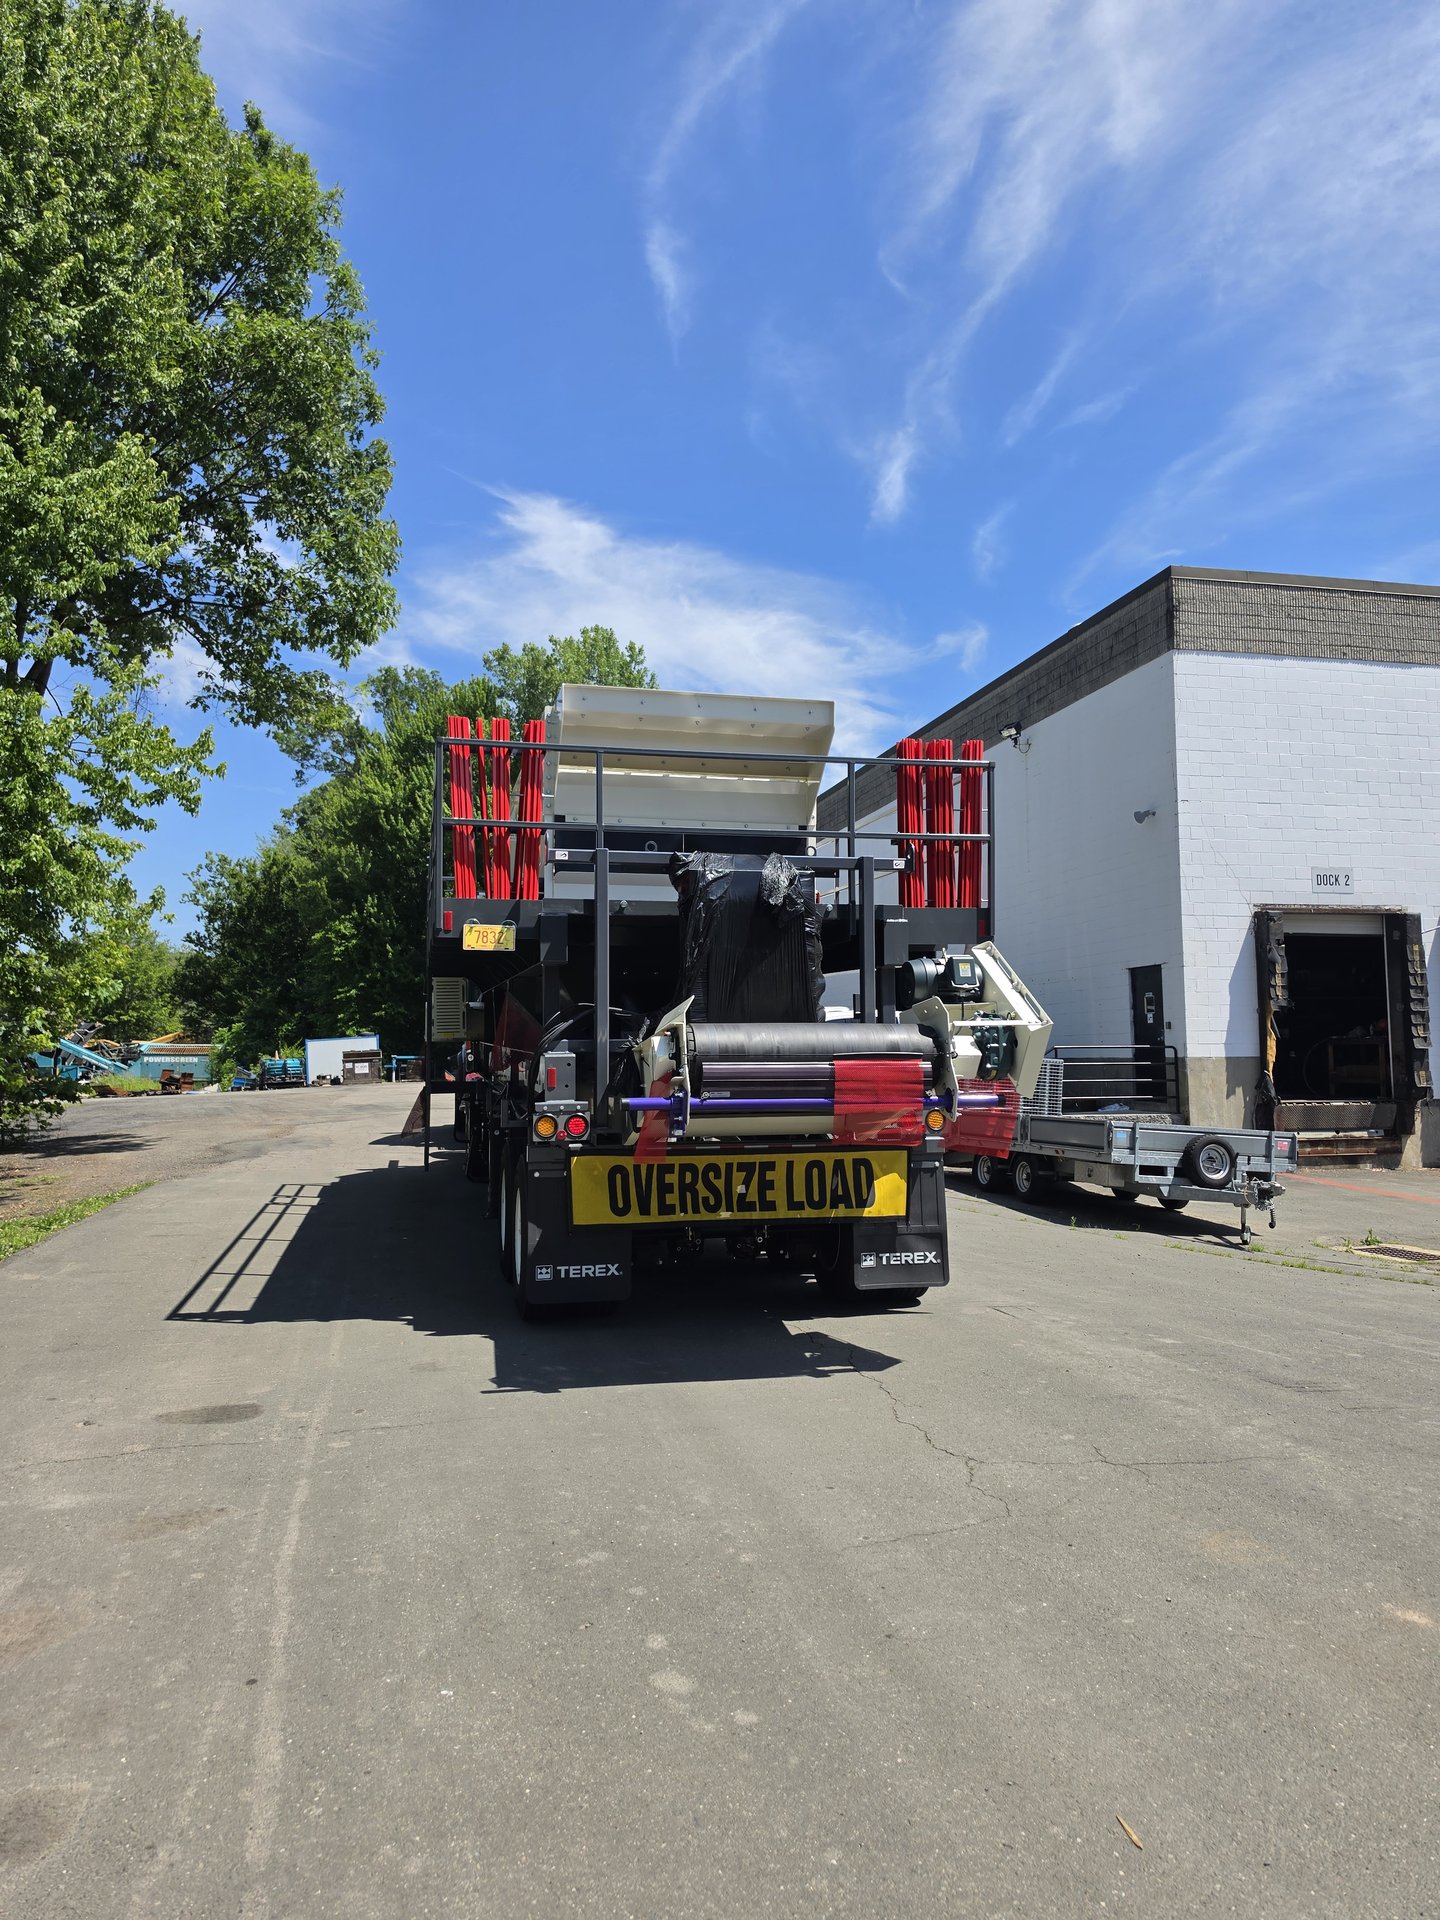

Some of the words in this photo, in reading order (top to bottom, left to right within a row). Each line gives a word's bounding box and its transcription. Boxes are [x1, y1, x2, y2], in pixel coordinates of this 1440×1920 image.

[1316, 873, 1340, 886] DOCK
[1344, 874, 1350, 886] 2
[474, 930, 504, 945] 7832
[607, 1159, 777, 1217] OVERSIZE
[786, 1157, 877, 1212] LOAD
[878, 1251, 938, 1265] TEREX
[556, 1263, 620, 1278] TEREX
